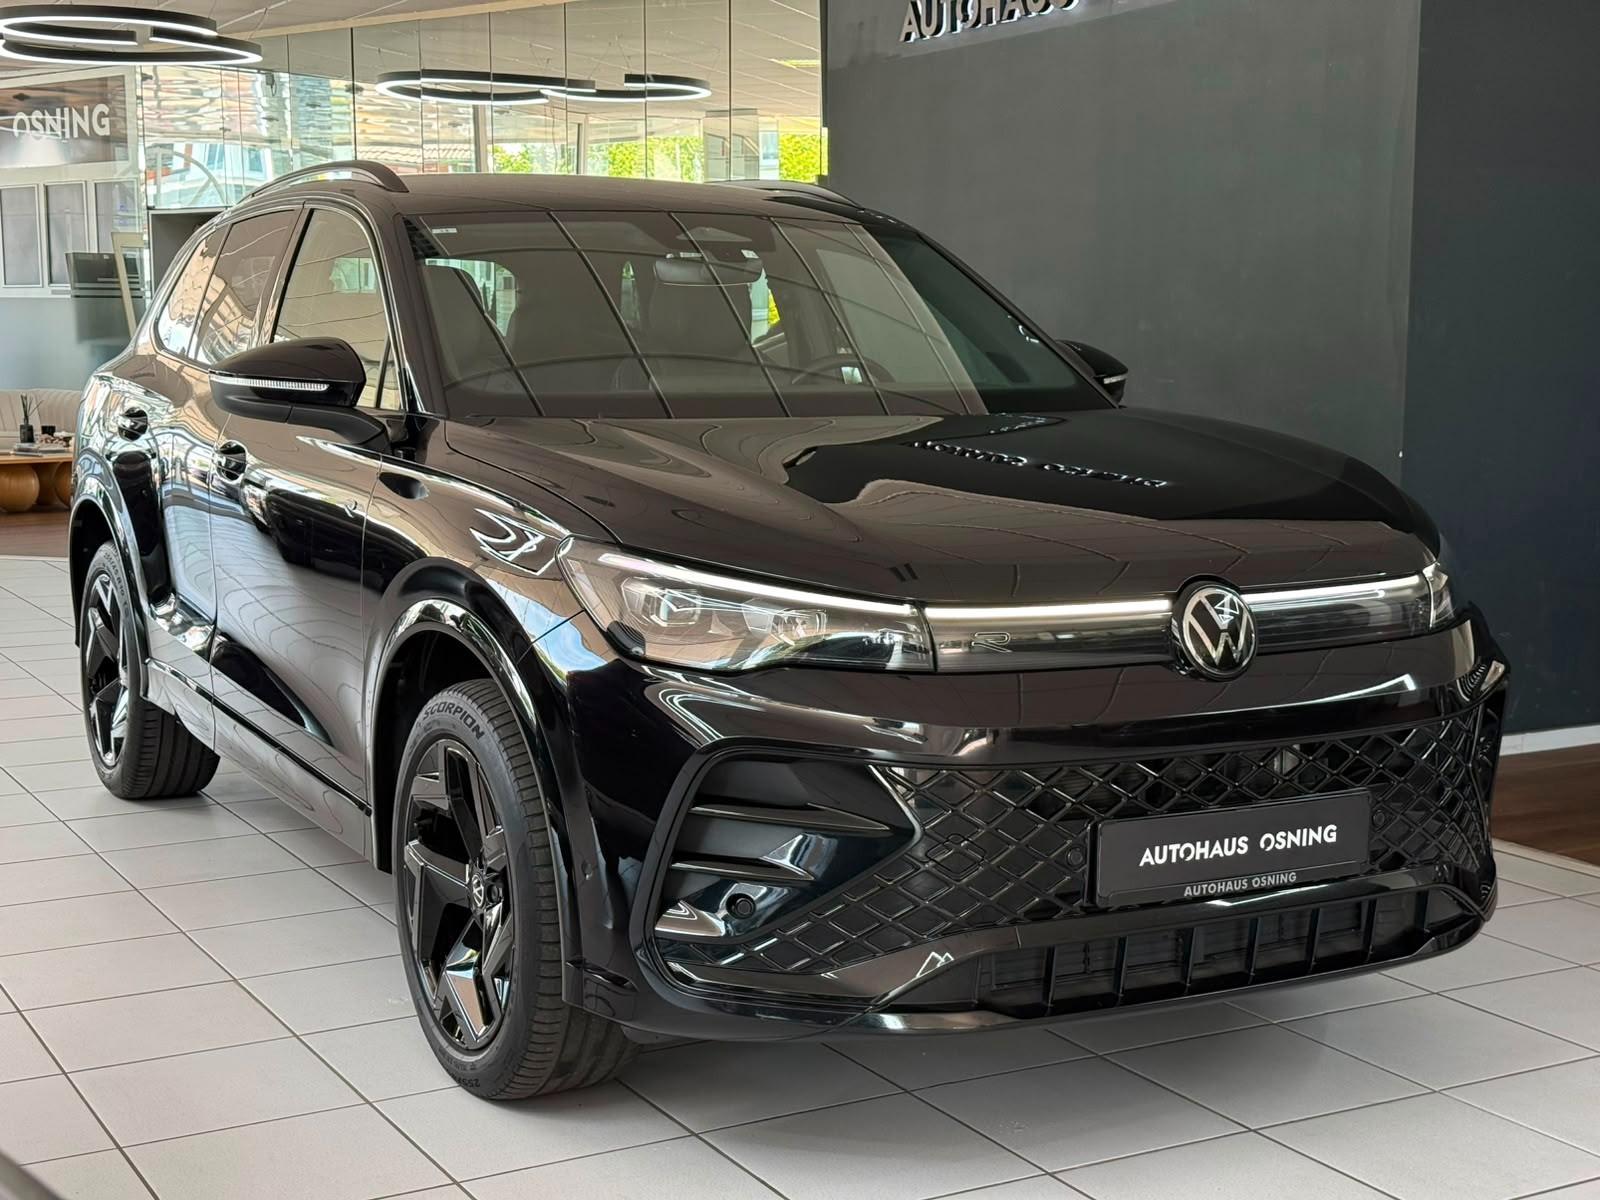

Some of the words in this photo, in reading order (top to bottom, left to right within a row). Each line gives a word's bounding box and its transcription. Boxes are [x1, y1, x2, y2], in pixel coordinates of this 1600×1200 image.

[899, 0, 1070, 42] AUTOH
[13, 104, 110, 140] OSNING
[971, 631, 1012, 653] R
[423, 701, 485, 740] SCORPION
[1139, 836, 1249, 867] AUTOHAUS
[1259, 824, 1337, 851] OSNING
[1183, 878, 1248, 897] AUTOHAUS
[1252, 872, 1297, 889] OSNING
